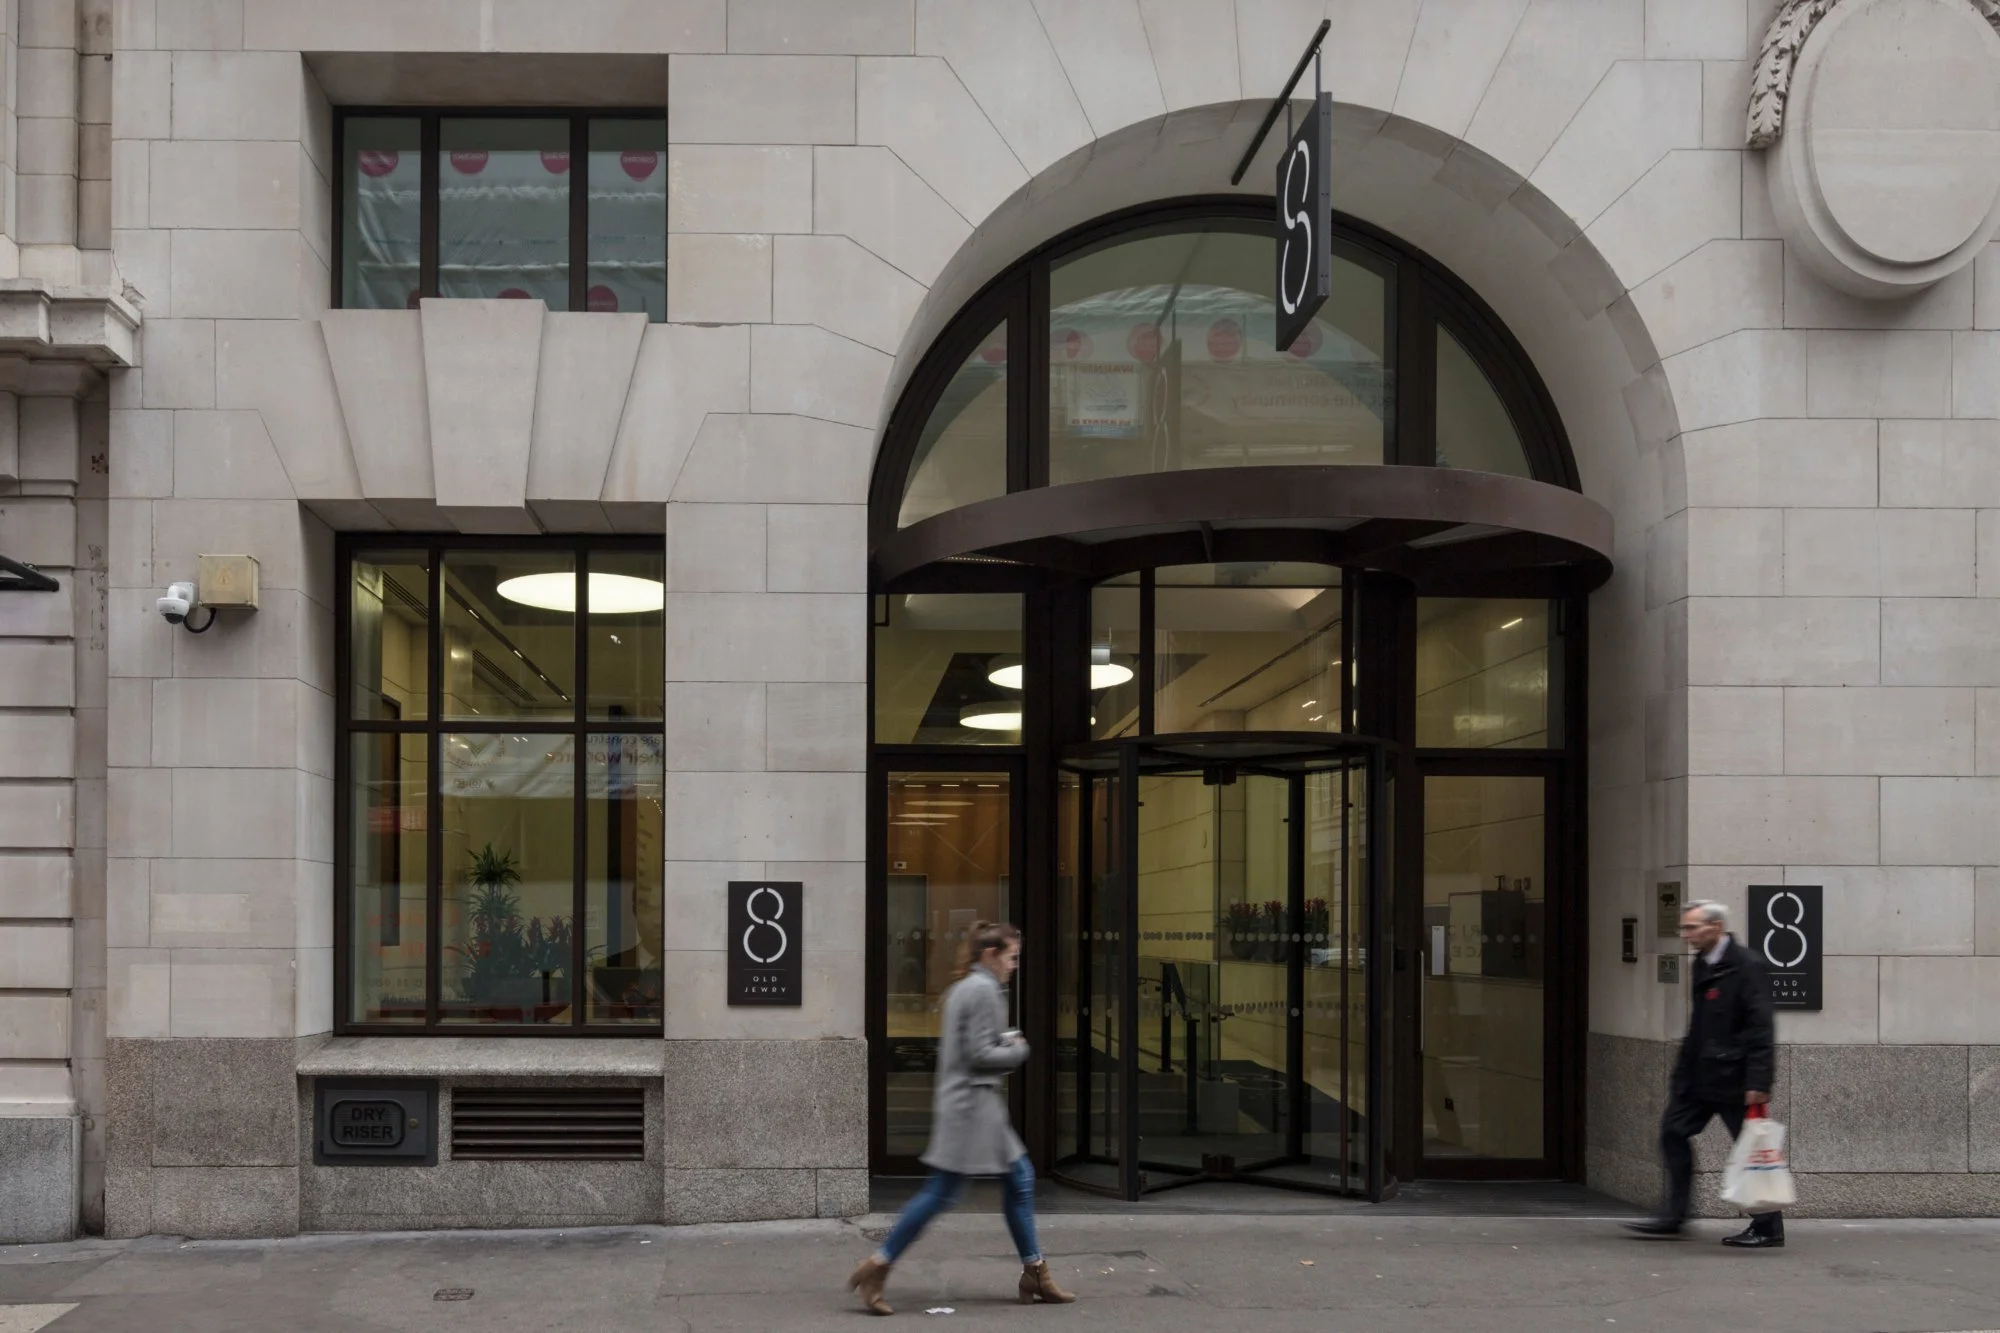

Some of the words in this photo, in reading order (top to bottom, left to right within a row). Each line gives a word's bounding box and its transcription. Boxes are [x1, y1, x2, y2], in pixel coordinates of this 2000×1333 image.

[1280, 138, 1312, 315] 8
[743, 887, 787, 963] 8
[1763, 892, 1808, 968] 8
[342, 1125, 394, 1139] RISER
[351, 1107, 386, 1121] DRY
